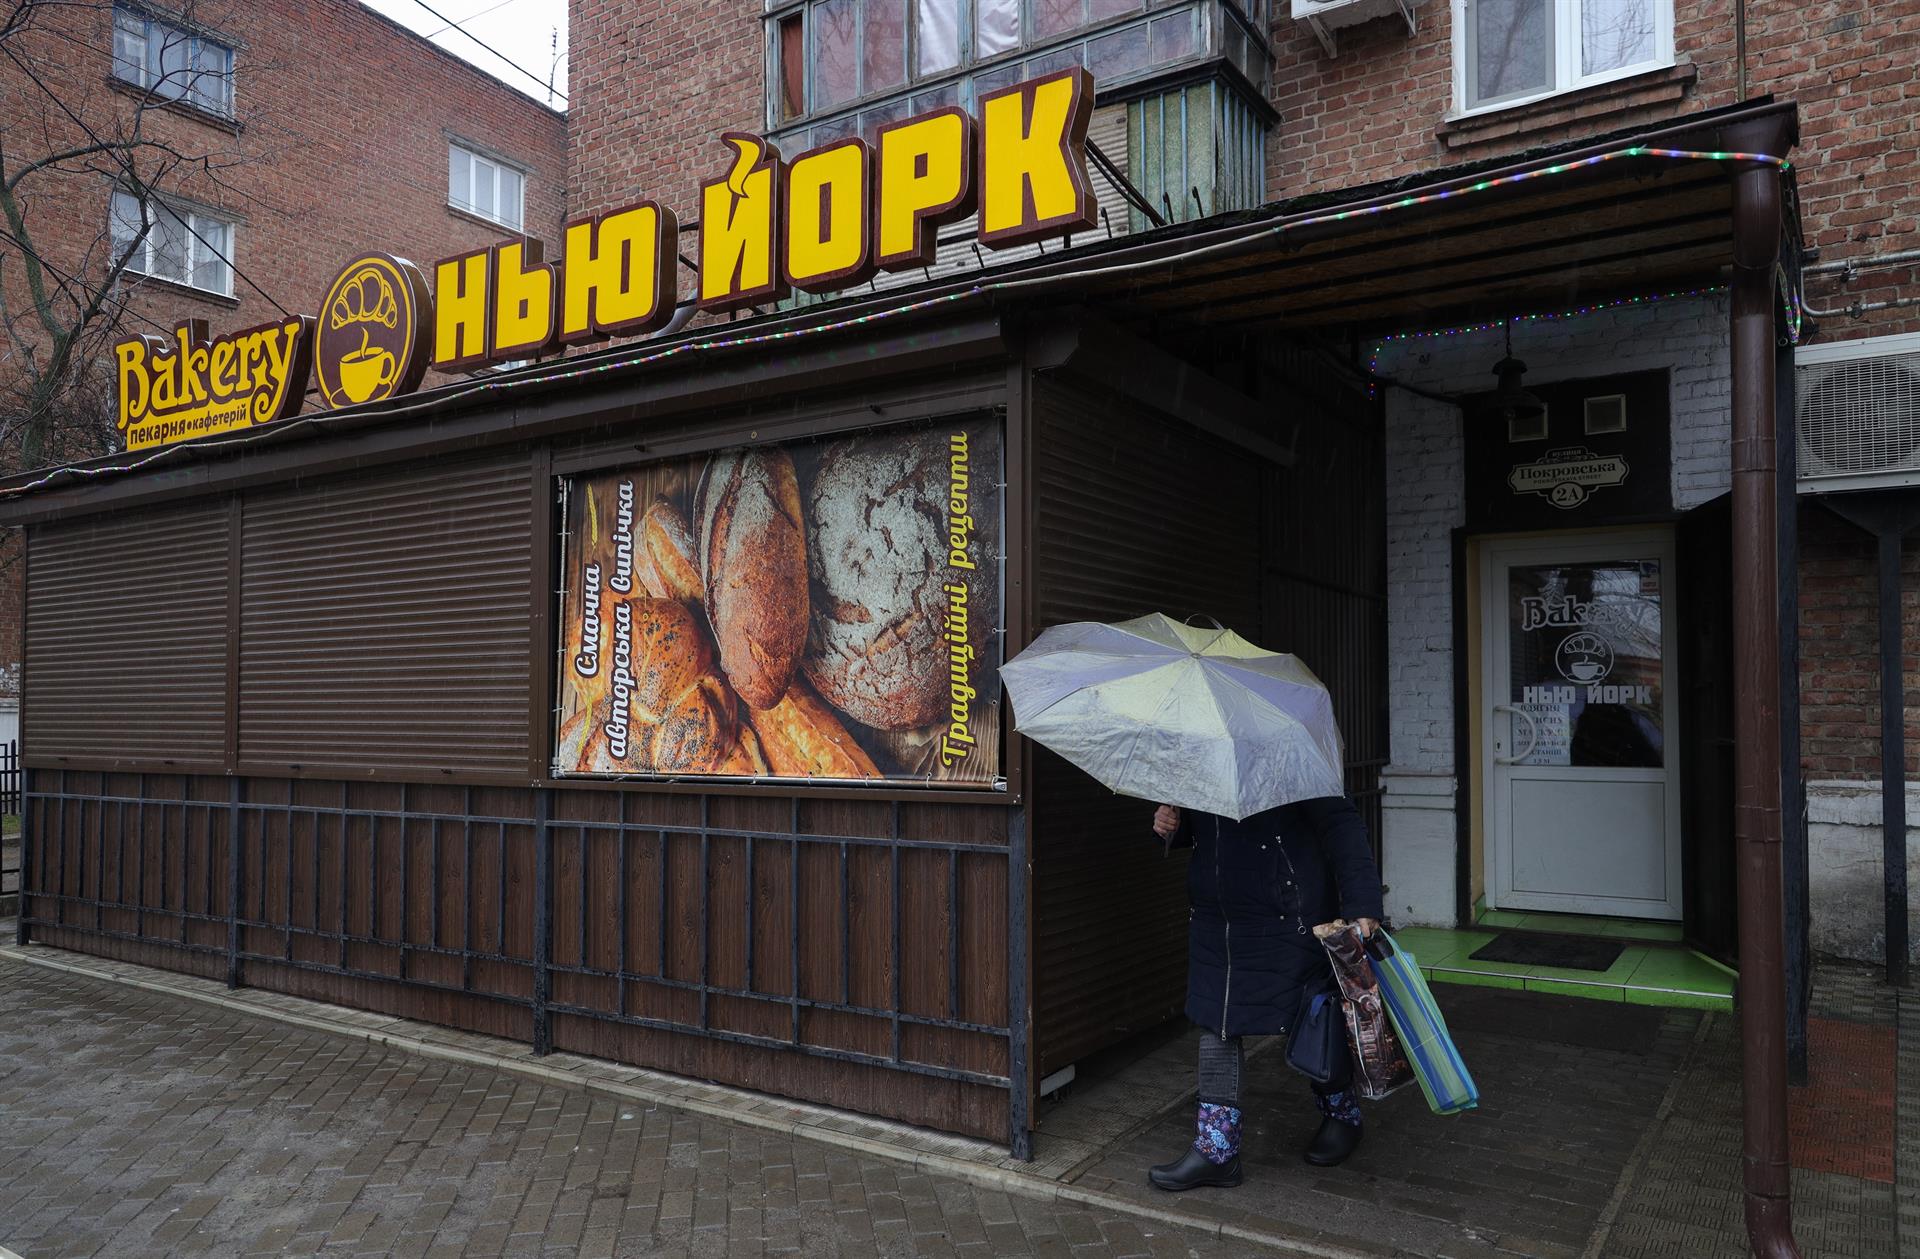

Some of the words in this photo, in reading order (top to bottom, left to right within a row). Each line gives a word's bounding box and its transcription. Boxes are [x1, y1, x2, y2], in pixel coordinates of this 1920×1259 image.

[435, 206, 657, 363] НЬЮ
[702, 76, 1077, 300] ЙОРК
[115, 322, 300, 429] Bakery
[130, 418, 185, 445] пекарня
[192, 407, 247, 432] кафетерій
[949, 431, 976, 569] рецепти
[1520, 463, 1616, 480] Покровська
[611, 481, 633, 594] випічка
[575, 564, 600, 678] Смачна
[941, 582, 977, 766] Традиційні
[608, 602, 637, 758] авторська
[1523, 686, 1576, 704] НЬЮ
[1587, 682, 1652, 704] ЙОРК
